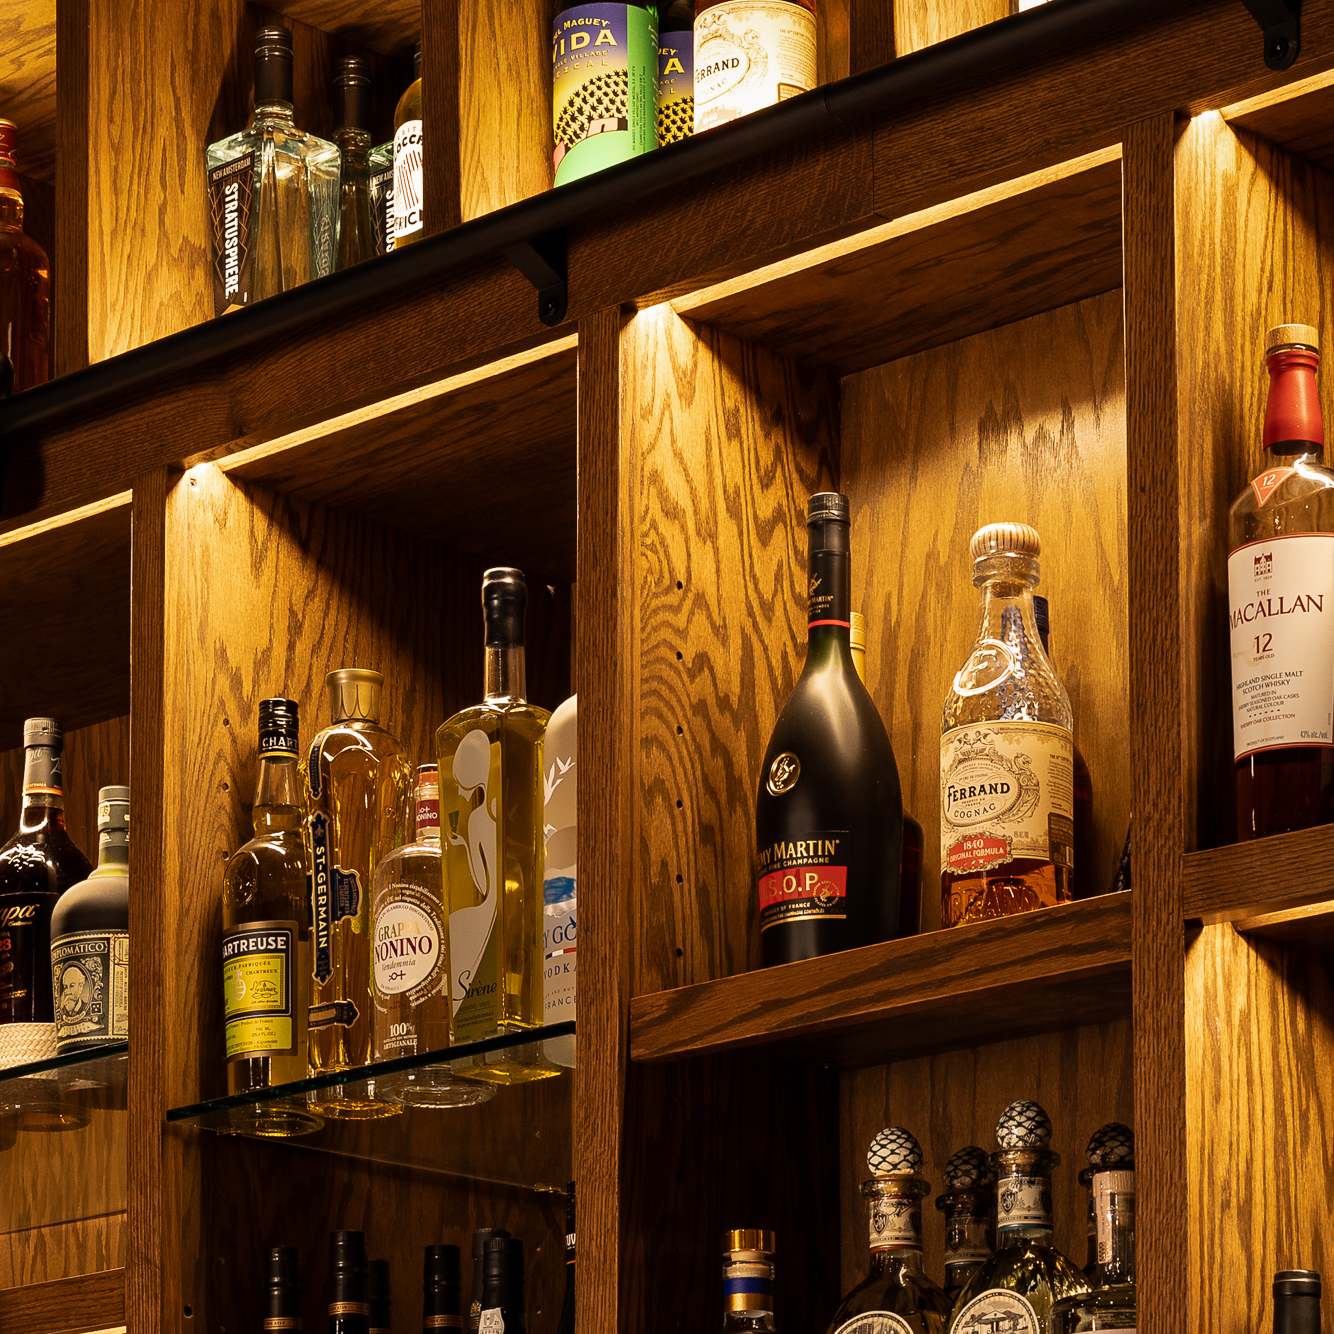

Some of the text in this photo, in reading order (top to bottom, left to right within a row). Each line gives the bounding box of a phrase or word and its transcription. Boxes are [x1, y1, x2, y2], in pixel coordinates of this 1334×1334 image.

[563, 17, 610, 32] MAGUEY
[552, 29, 618, 65] VIDA
[570, 50, 609, 61] VILLAGE
[212, 156, 252, 181] NEW AMSTERDAM
[1229, 594, 1324, 632] MACALLAN
[1254, 632, 1274, 655] 12
[946, 782, 1011, 813] FERRAND
[953, 803, 996, 818] COGNAC
[774, 840, 835, 861] MARTIN
[963, 838, 984, 850] 1840
[973, 847, 1004, 857] FORMULA
[782, 857, 830, 867] CHAMPAGNE
[788, 902, 811, 910] FRANCE
[378, 920, 422, 943] GRAPPA
[374, 935, 434, 966] NONINO
[245, 967, 279, 977] CHARTREUX
[381, 959, 417, 974] Vendemmia
[452, 969, 499, 1002] Sirène
[389, 1022, 417, 1038] 100%
[383, 1037, 418, 1051] ARTIGIANALE
